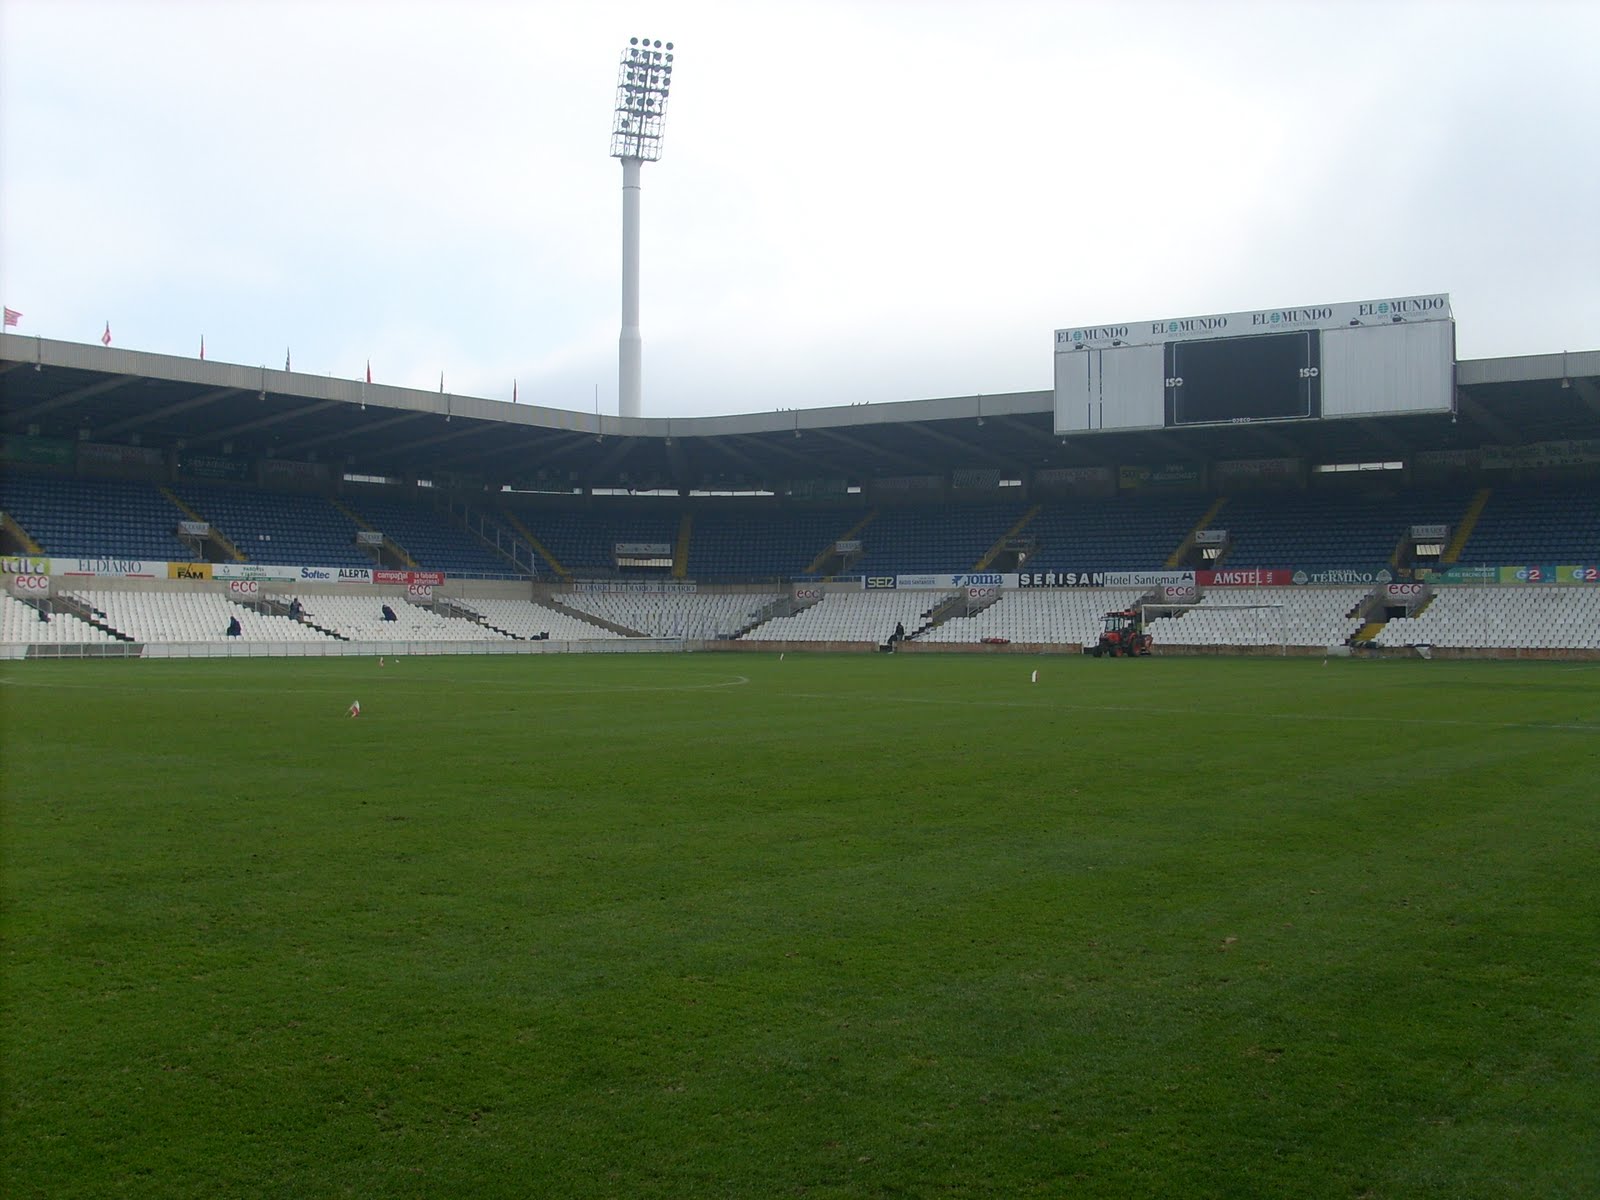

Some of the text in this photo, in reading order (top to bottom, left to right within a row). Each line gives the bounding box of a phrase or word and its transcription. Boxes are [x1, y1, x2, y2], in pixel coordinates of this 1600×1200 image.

[1359, 303, 1378, 316] EL
[1390, 298, 1444, 313] MUNDO
[1252, 308, 1332, 326] EL MUNDO
[1152, 317, 1227, 335] EL MUNDO
[1057, 332, 1072, 343] EL
[1083, 327, 1128, 341] MUNDO
[79, 559, 142, 573] EL DIARIO
[301, 568, 330, 579] Softec
[338, 569, 369, 579] ALERTA
[1020, 573, 1103, 585] SERISAN
[1214, 572, 1262, 584] AMSTEL
[1516, 569, 1540, 580] G2
[1573, 568, 1597, 580] G2
[1105, 575, 1179, 585] Hotel Santemar
